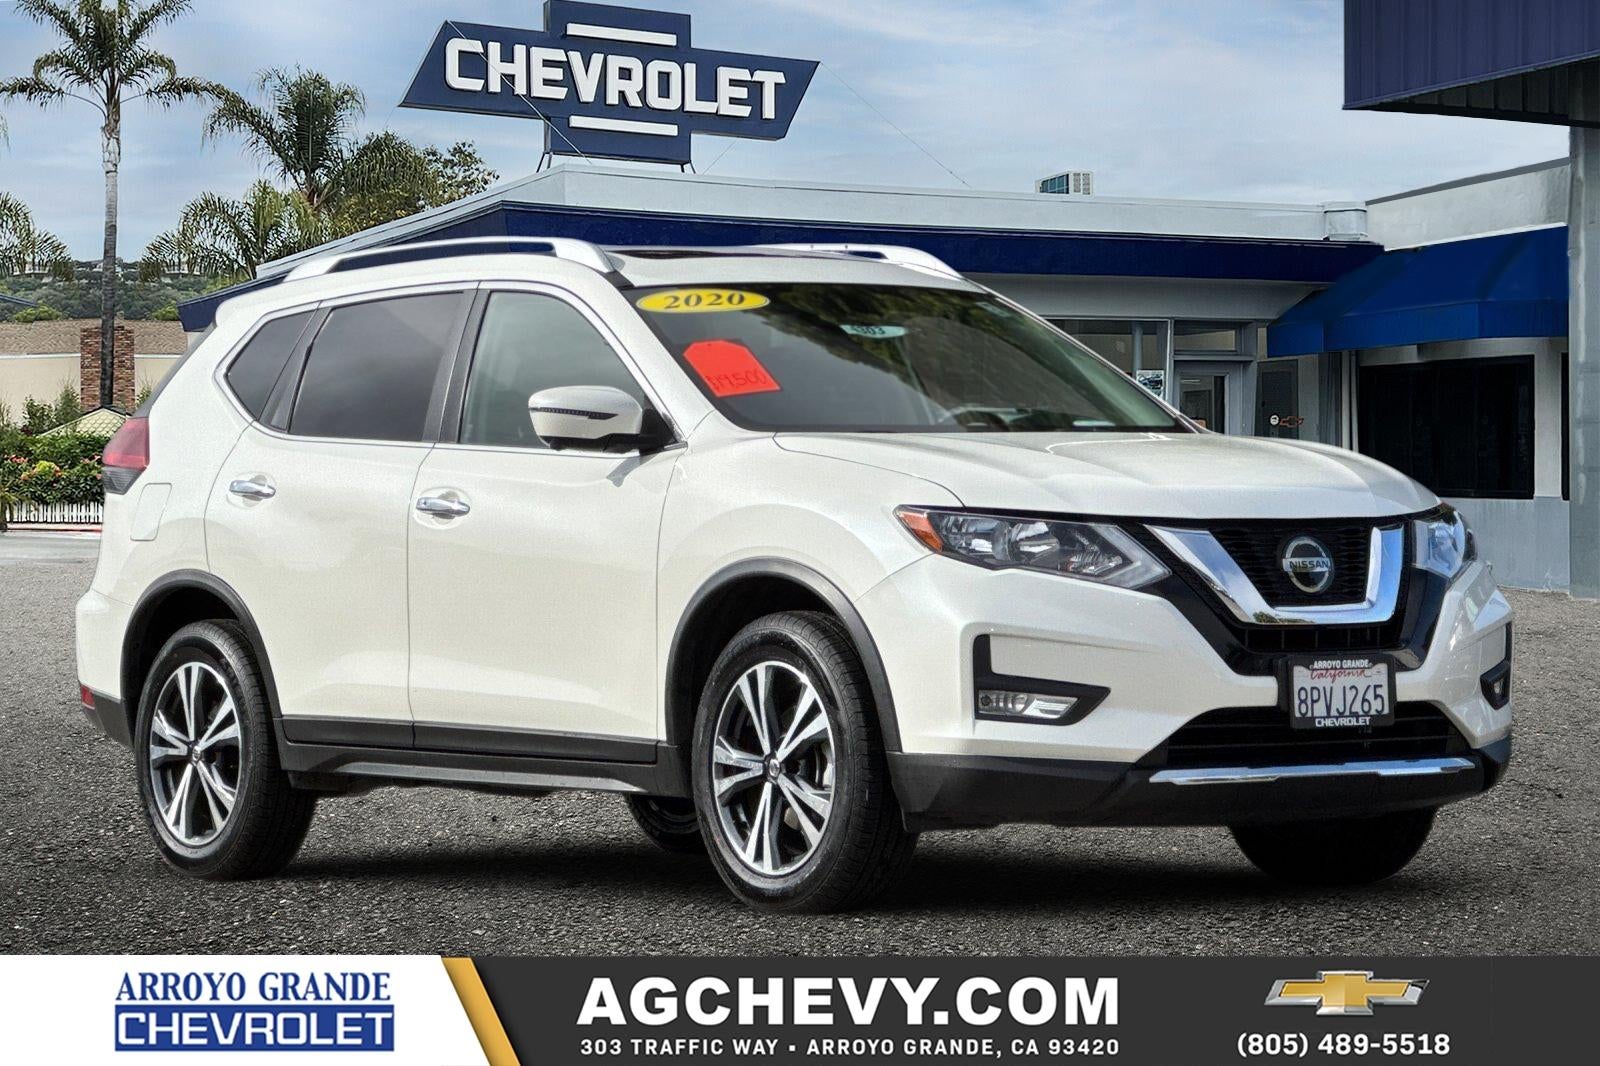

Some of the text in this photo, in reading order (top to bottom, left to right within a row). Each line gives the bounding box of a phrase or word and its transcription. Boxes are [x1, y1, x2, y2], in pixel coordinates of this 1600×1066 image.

[445, 38, 786, 119] CHEVROLET
[663, 292, 746, 310] 2020
[1290, 560, 1329, 569] NISSAN
[1313, 659, 1369, 669] ARROYO GRANDE
[1310, 668, 1371, 683] California
[1297, 684, 1385, 717] 8PVJ265
[1315, 716, 1371, 727] CHEVROLET
